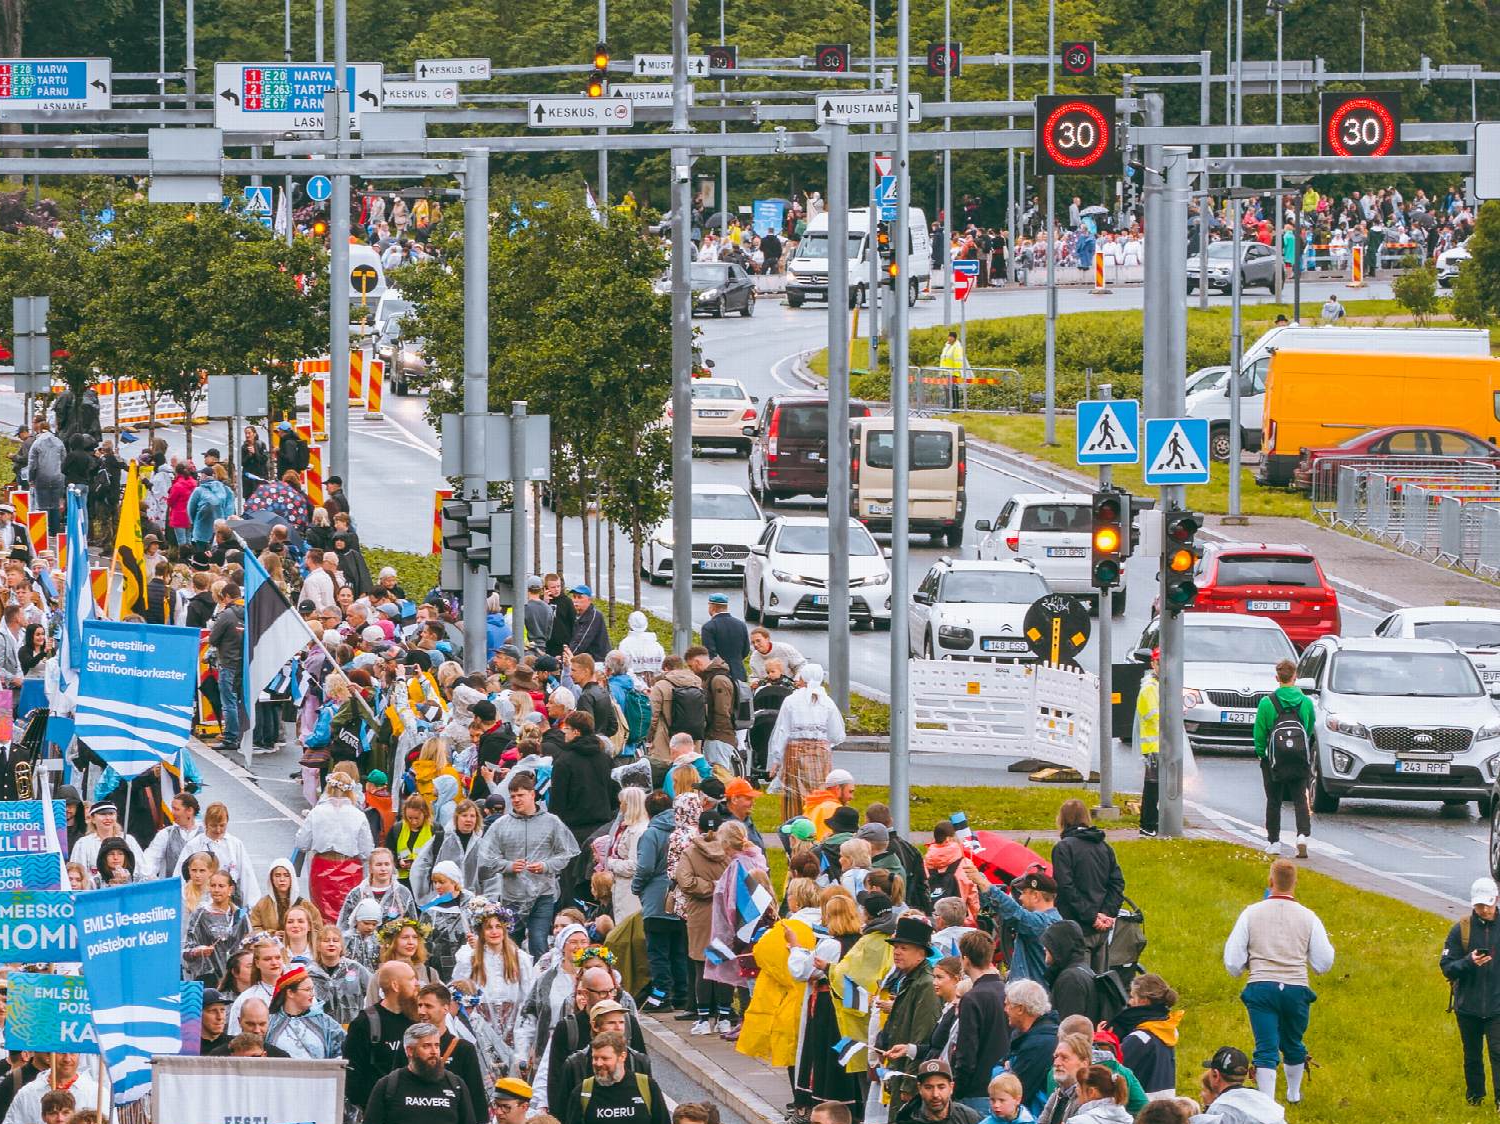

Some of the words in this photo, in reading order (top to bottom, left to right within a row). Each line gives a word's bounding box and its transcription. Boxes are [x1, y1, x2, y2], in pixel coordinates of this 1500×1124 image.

[824, 55, 840, 67] 30
[1070, 53, 1086, 65] 30
[13, 65, 18, 74] E
[36, 64, 69, 74] NARVA
[469, 66, 476, 74] C
[13, 76, 18, 85] E
[20, 76, 34, 85] 263
[37, 76, 67, 85] TARTU
[250, 71, 256, 80] 1
[264, 71, 270, 81] E
[273, 71, 286, 81] 20
[294, 71, 332, 81] NARVA
[13, 87, 18, 96] E
[37, 86, 69, 96] PÄRNU
[250, 84, 257, 95] 2
[264, 84, 270, 95] E
[273, 84, 290, 95] 263
[389, 89, 430, 100] KESKUS,
[435, 89, 441, 99] C
[250, 98, 257, 108] 4
[264, 98, 270, 108] E
[273, 98, 285, 108] 67
[294, 96, 324, 109] PÄRN
[549, 106, 599, 120] KESKUS,
[605, 107, 612, 117] C
[1058, 121, 1095, 149] 30
[1343, 118, 1380, 145] 30
[88, 635, 156, 652] Üle-eestiline
[991, 640, 1005, 651] 148
[1009, 640, 1026, 651] ESS
[87, 650, 127, 662] Noorte
[86, 662, 188, 681] Sümfooniaorkester
[1228, 713, 1245, 723] 423
[1403, 762, 1421, 772] 243
[1426, 763, 1447, 773] RPF
[0, 903, 75, 919] MEESKO
[83, 913, 113, 935] EMLS
[138, 931, 169, 947] Kalev
[34, 986, 71, 1000] EMLS
[405, 1096, 450, 1108] RAKVERE
[596, 1106, 635, 1119] KOERU
